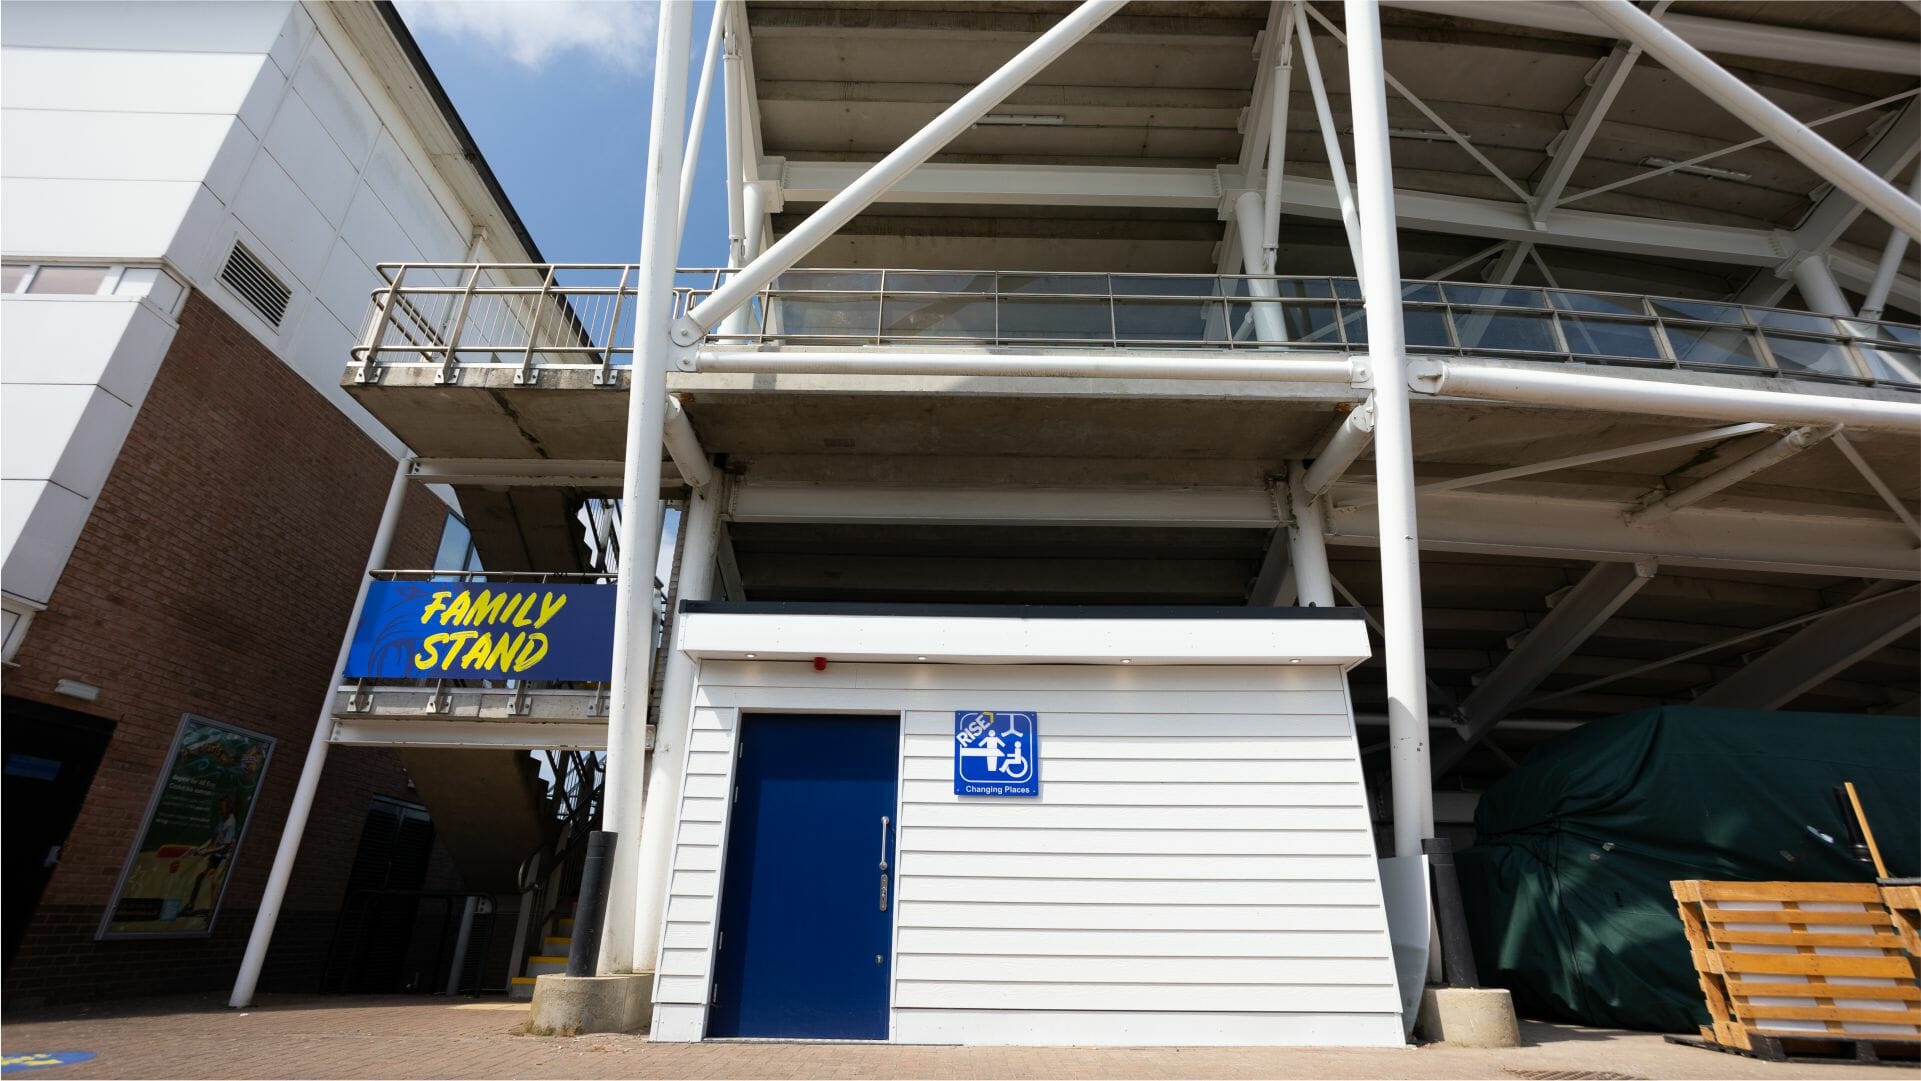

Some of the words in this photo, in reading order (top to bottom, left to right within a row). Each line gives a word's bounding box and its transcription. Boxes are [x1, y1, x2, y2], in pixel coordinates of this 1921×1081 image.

[420, 589, 567, 629] FAMILY
[414, 631, 548, 673] STAND
[956, 714, 991, 748] RISE
[965, 785, 1003, 795] Changing
[1004, 785, 1030, 794] Places
